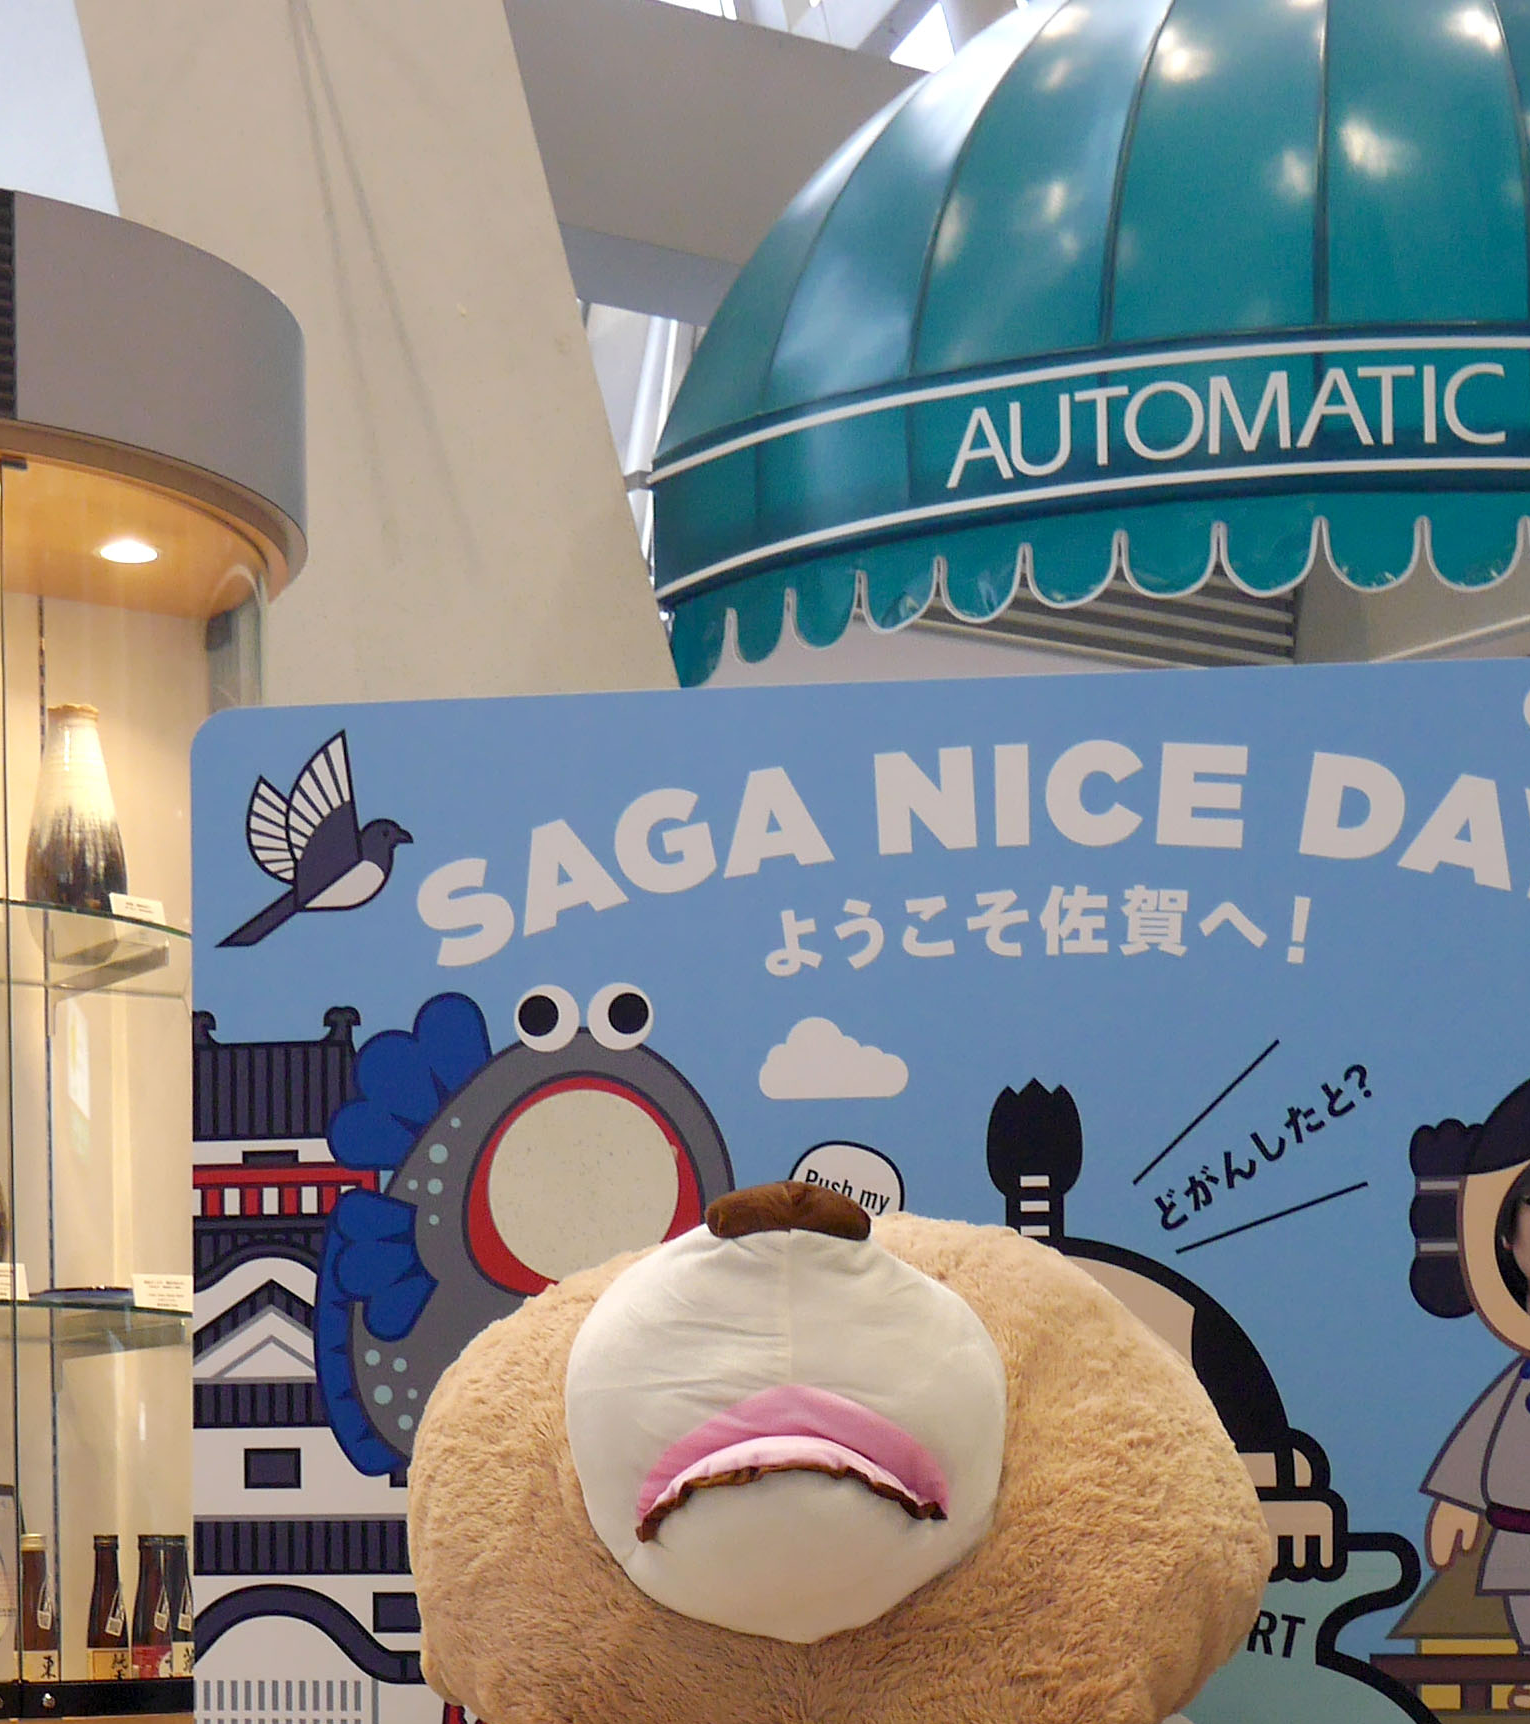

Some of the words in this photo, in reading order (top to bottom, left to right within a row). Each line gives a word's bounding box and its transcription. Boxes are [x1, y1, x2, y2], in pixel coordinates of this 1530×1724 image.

[948, 363, 1506, 488] AUTOMATIC
[416, 766, 836, 968] SAGA
[873, 738, 1250, 856] NICE
[764, 884, 1311, 977] ようこそ佐賀へ!
[860, 1189, 890, 1216] my
[1158, 1062, 1374, 1231] どがんしたと?
